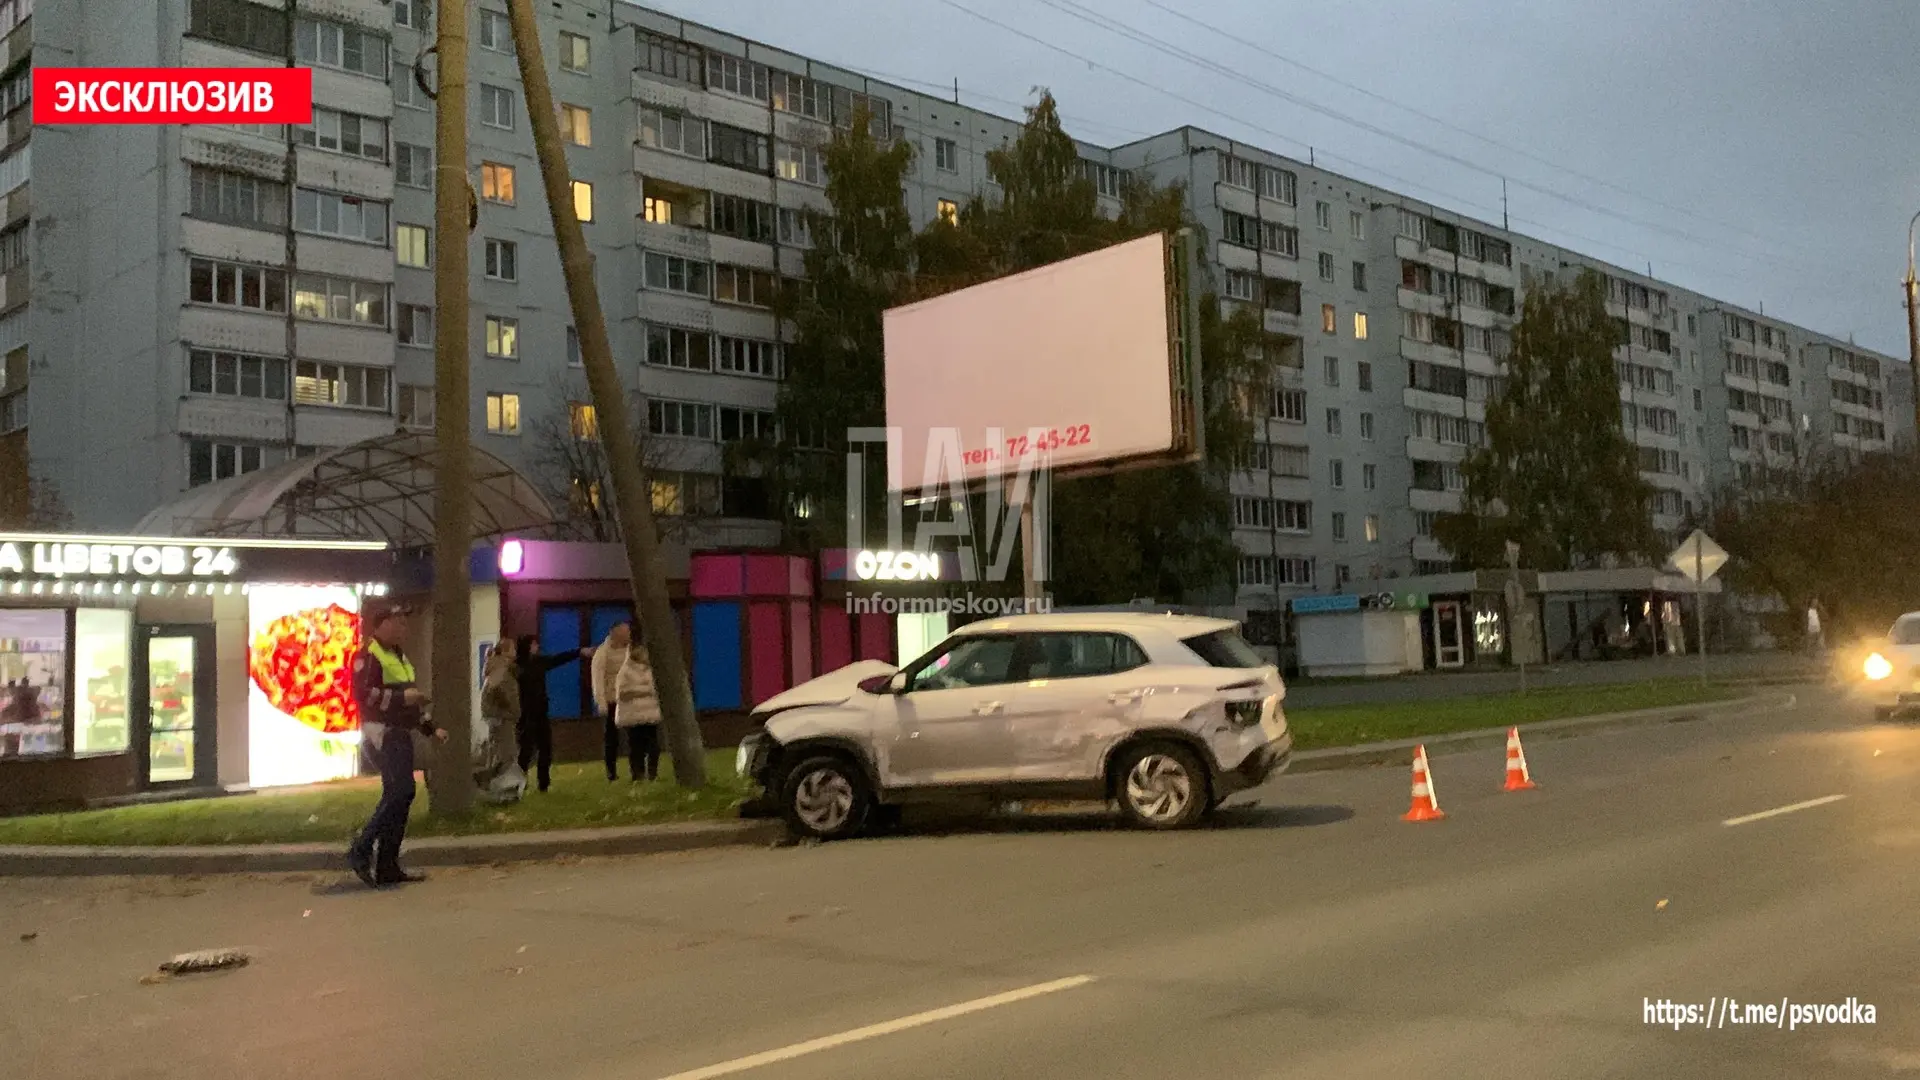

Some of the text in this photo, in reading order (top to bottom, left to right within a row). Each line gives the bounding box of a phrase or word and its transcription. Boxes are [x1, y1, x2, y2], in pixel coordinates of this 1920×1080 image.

[963, 424, 1090, 465] тел. 72-45-22
[33, 543, 185, 578] ЦВЕТОВ
[192, 547, 236, 575] 24
[855, 550, 939, 580] OZON
